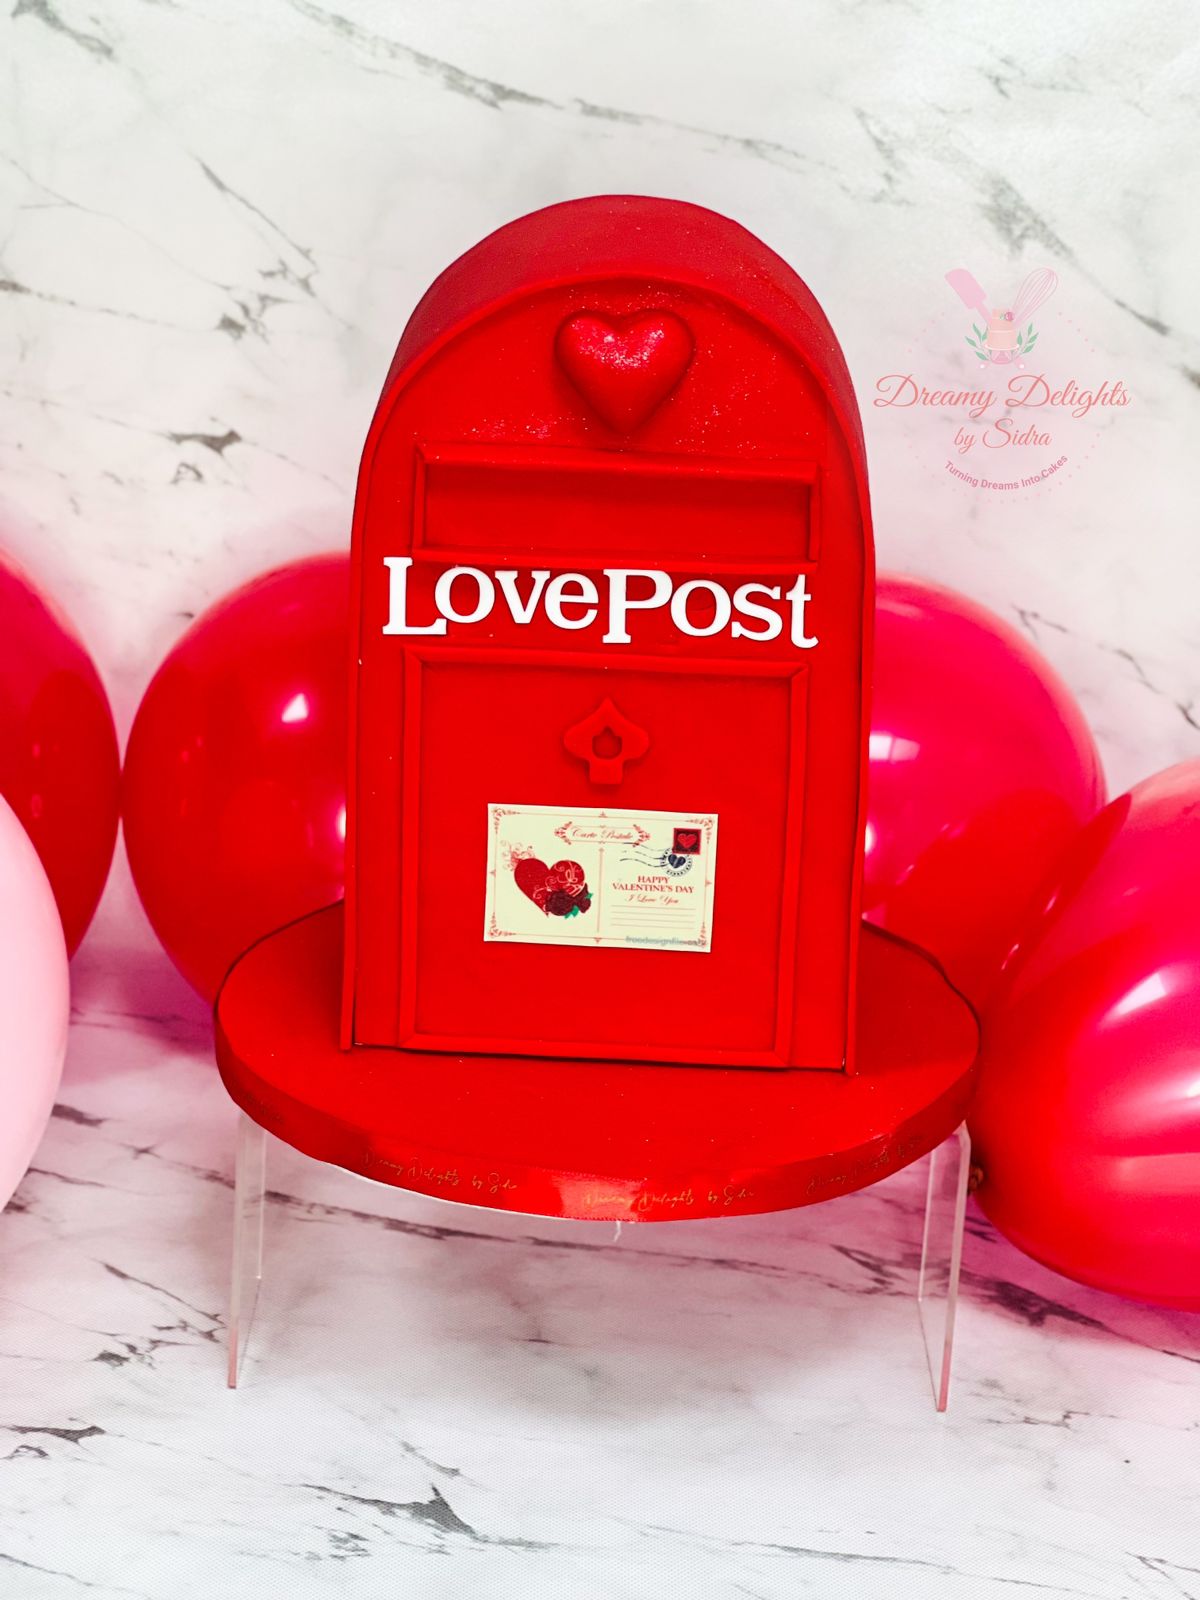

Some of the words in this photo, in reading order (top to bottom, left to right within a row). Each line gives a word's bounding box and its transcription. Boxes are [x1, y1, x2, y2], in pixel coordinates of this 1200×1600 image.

[637, 875, 669, 884] HAPPY
[612, 883, 673, 892] VALENTINE'S
[675, 886, 694, 894] DAY
